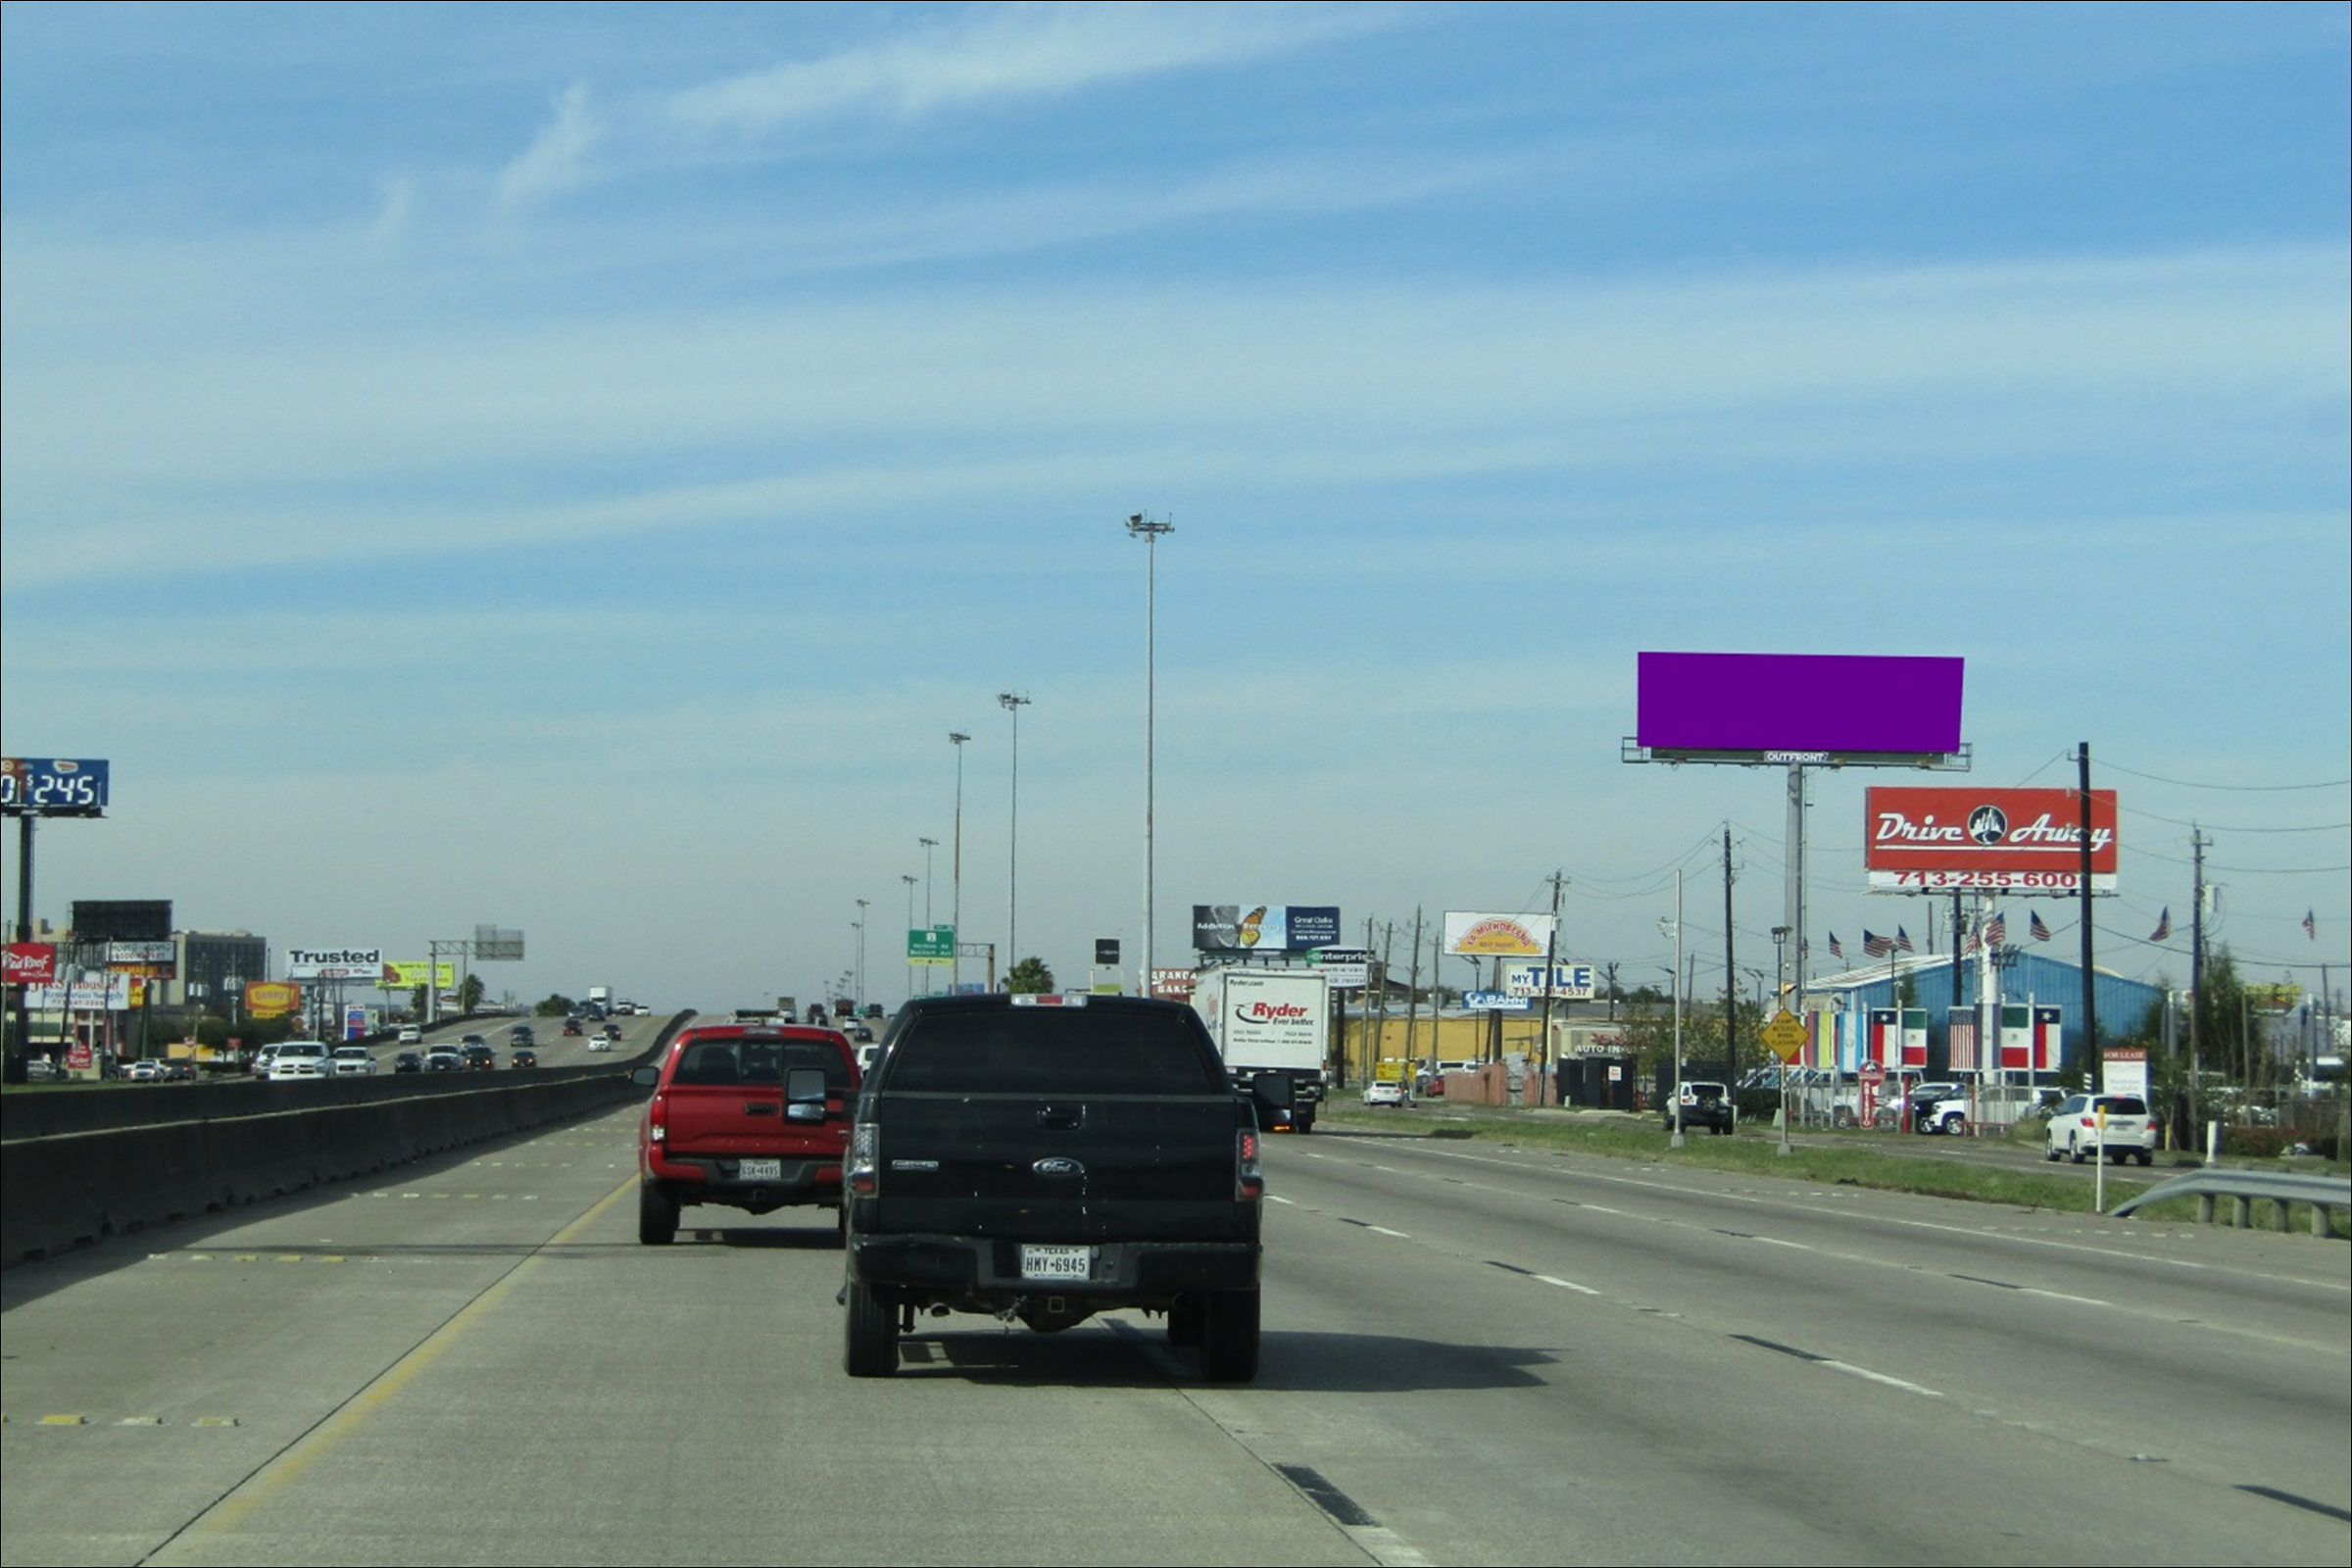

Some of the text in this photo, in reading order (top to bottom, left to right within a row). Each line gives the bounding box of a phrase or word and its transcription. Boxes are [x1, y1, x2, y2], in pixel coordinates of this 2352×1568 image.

[1767, 753, 1824, 761] OUTFRONT
[1876, 812, 1964, 841] Drive
[1893, 871, 2078, 887] 713-255-600
[24, 955, 50, 969] Roof
[289, 950, 379, 963] Trusted
[1511, 974, 1529, 984] MY
[1513, 987, 1588, 997] 713-38-4537
[1252, 1003, 1307, 1019] Ryder
[1575, 1045, 1604, 1054] AUTO
[1042, 1161, 1071, 1172] Ford
